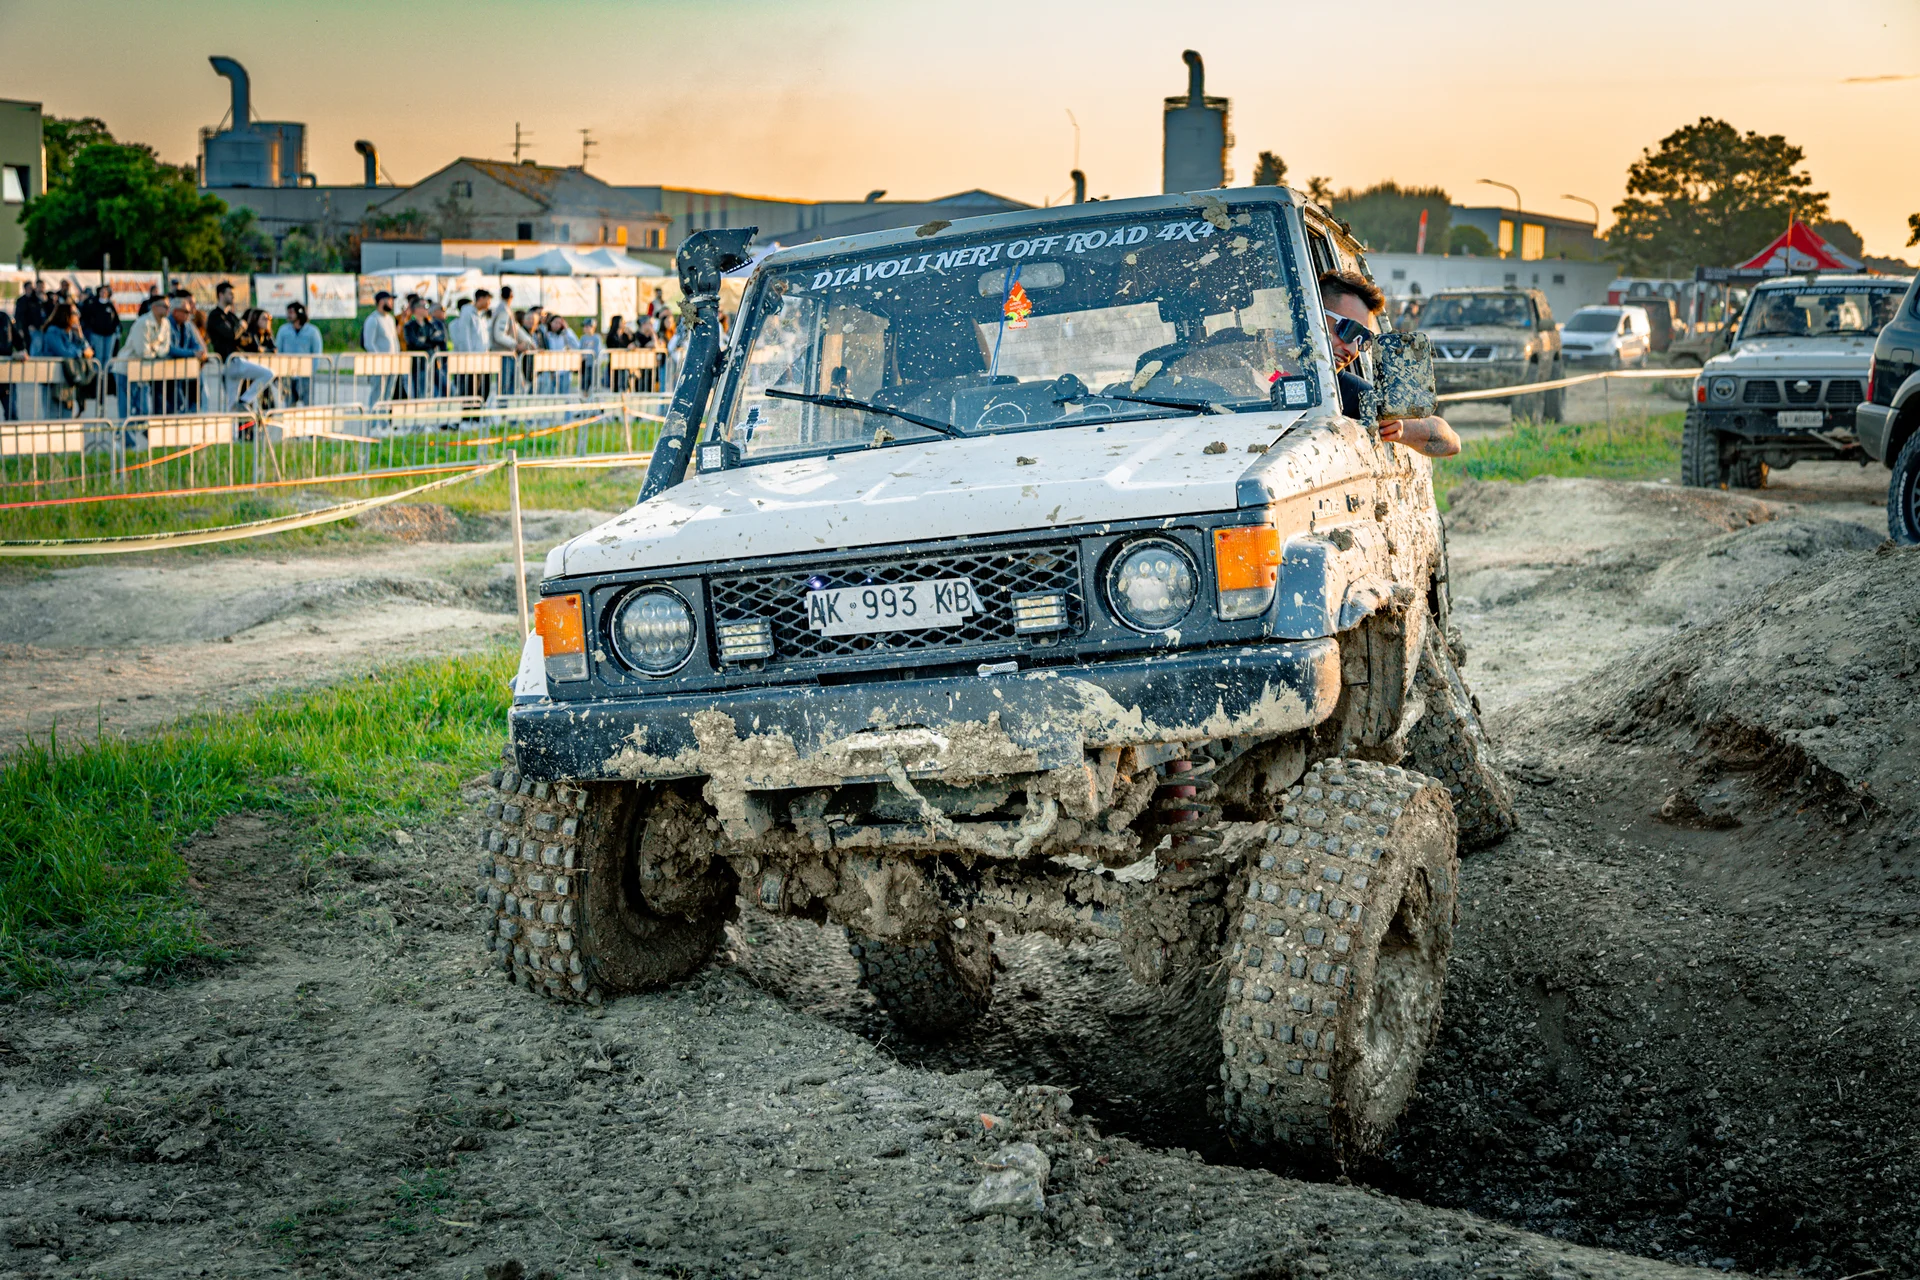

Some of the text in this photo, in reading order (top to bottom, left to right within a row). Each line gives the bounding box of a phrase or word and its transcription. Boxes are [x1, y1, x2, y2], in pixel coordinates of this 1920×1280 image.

[811, 220, 1216, 291] DIAVOLI NERI OFF ROAD 4X4
[810, 581, 972, 628] AK 993 KB
